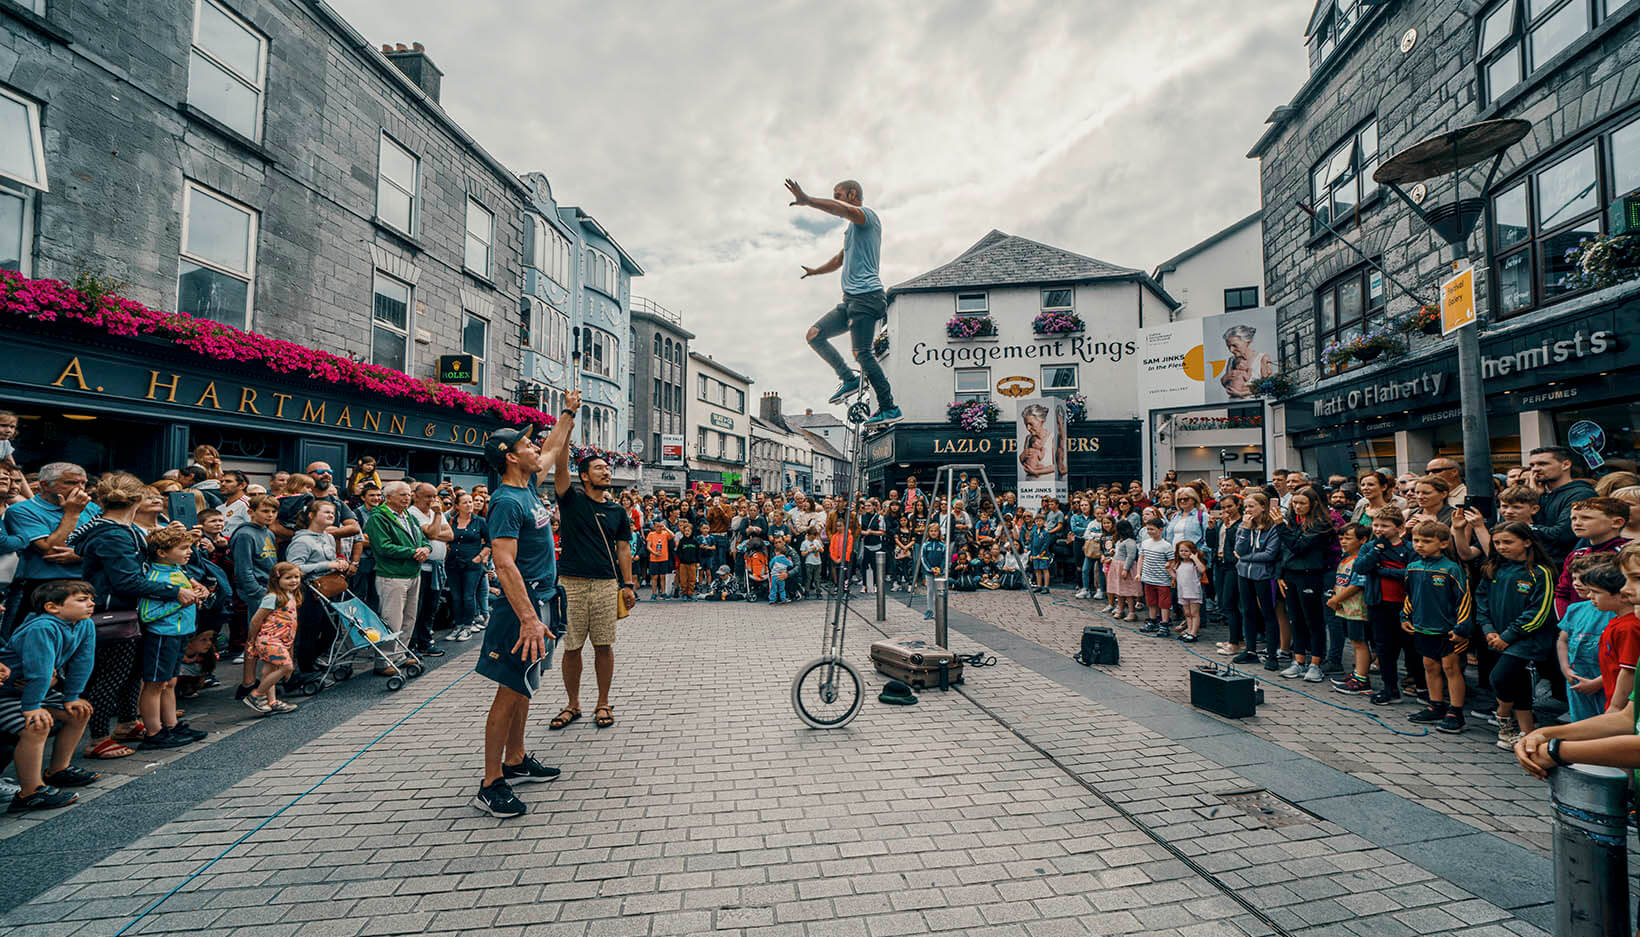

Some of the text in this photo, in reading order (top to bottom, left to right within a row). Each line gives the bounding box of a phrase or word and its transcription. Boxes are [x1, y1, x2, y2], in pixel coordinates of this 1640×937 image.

[912, 341, 1064, 368] Engagement
[1071, 336, 1137, 363] Rings
[1161, 354, 1185, 362] JINKS
[441, 371, 471, 379] ROLEX
[1314, 395, 1343, 417] Matt
[1481, 330, 1609, 379] hemists
[51, 356, 104, 392] A.
[144, 370, 407, 435] HARTMANN
[424, 423, 436, 438] &
[1523, 388, 1577, 405] PERFUMES
[1421, 408, 1463, 423] PRESCRIP
[933, 437, 1100, 454] LAZLO JEERS
